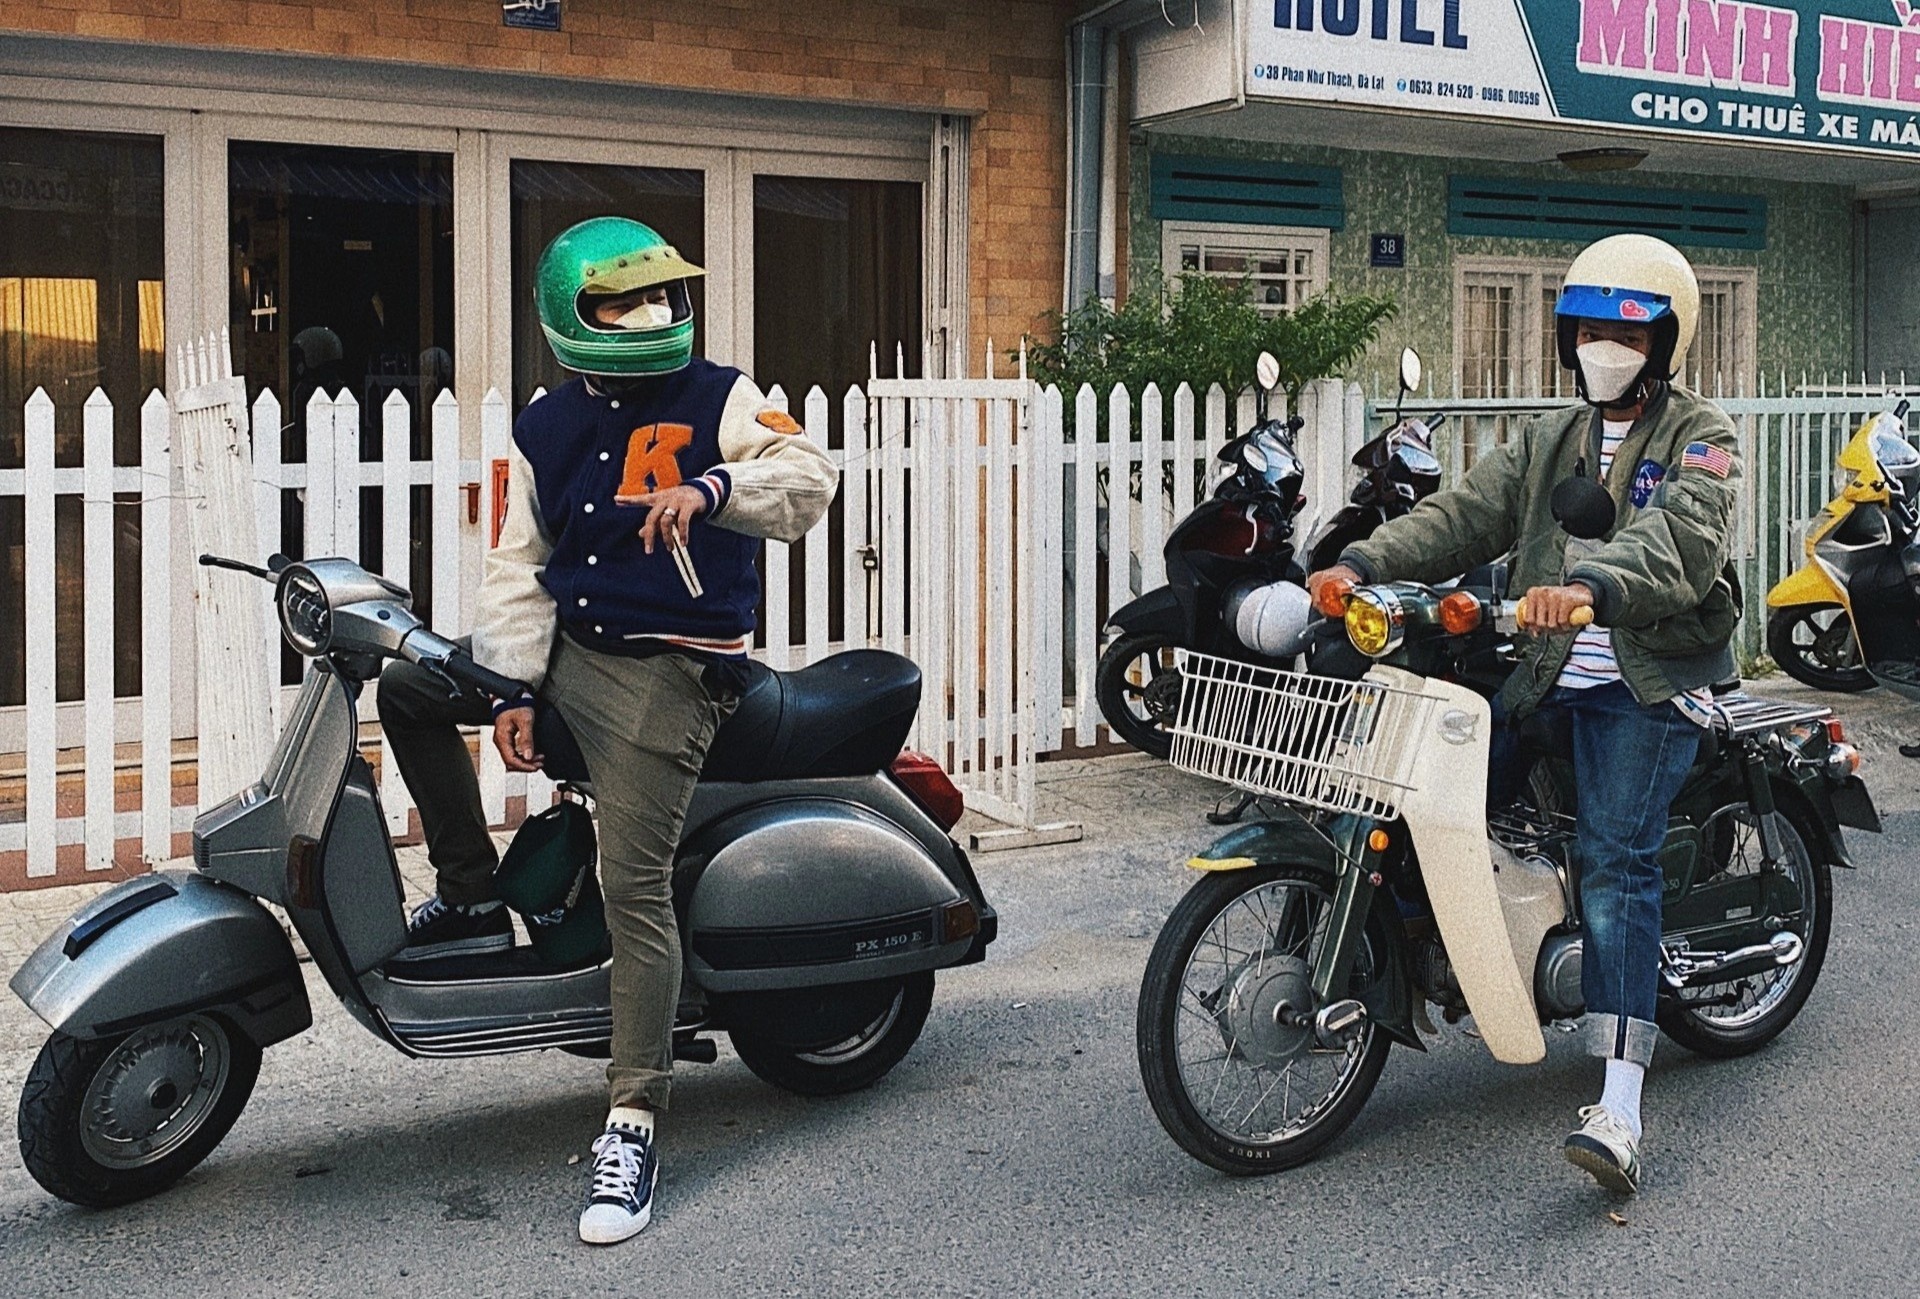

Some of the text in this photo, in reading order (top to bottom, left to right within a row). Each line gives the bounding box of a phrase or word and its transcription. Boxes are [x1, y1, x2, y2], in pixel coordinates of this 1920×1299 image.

[1577, 0, 1798, 96] MINH
[1266, 65, 1279, 80] 38
[1282, 66, 1304, 82] Phan
[1437, 82, 1454, 97] 824
[1457, 84, 1473, 99] 520
[1631, 92, 1708, 123] CHO
[1718, 101, 1806, 134] THUÊ
[1817, 112, 1859, 139] XE
[1380, 238, 1396, 254] 38
[617, 422, 693, 496] K
[855, 931, 922, 952] PX 150 E
